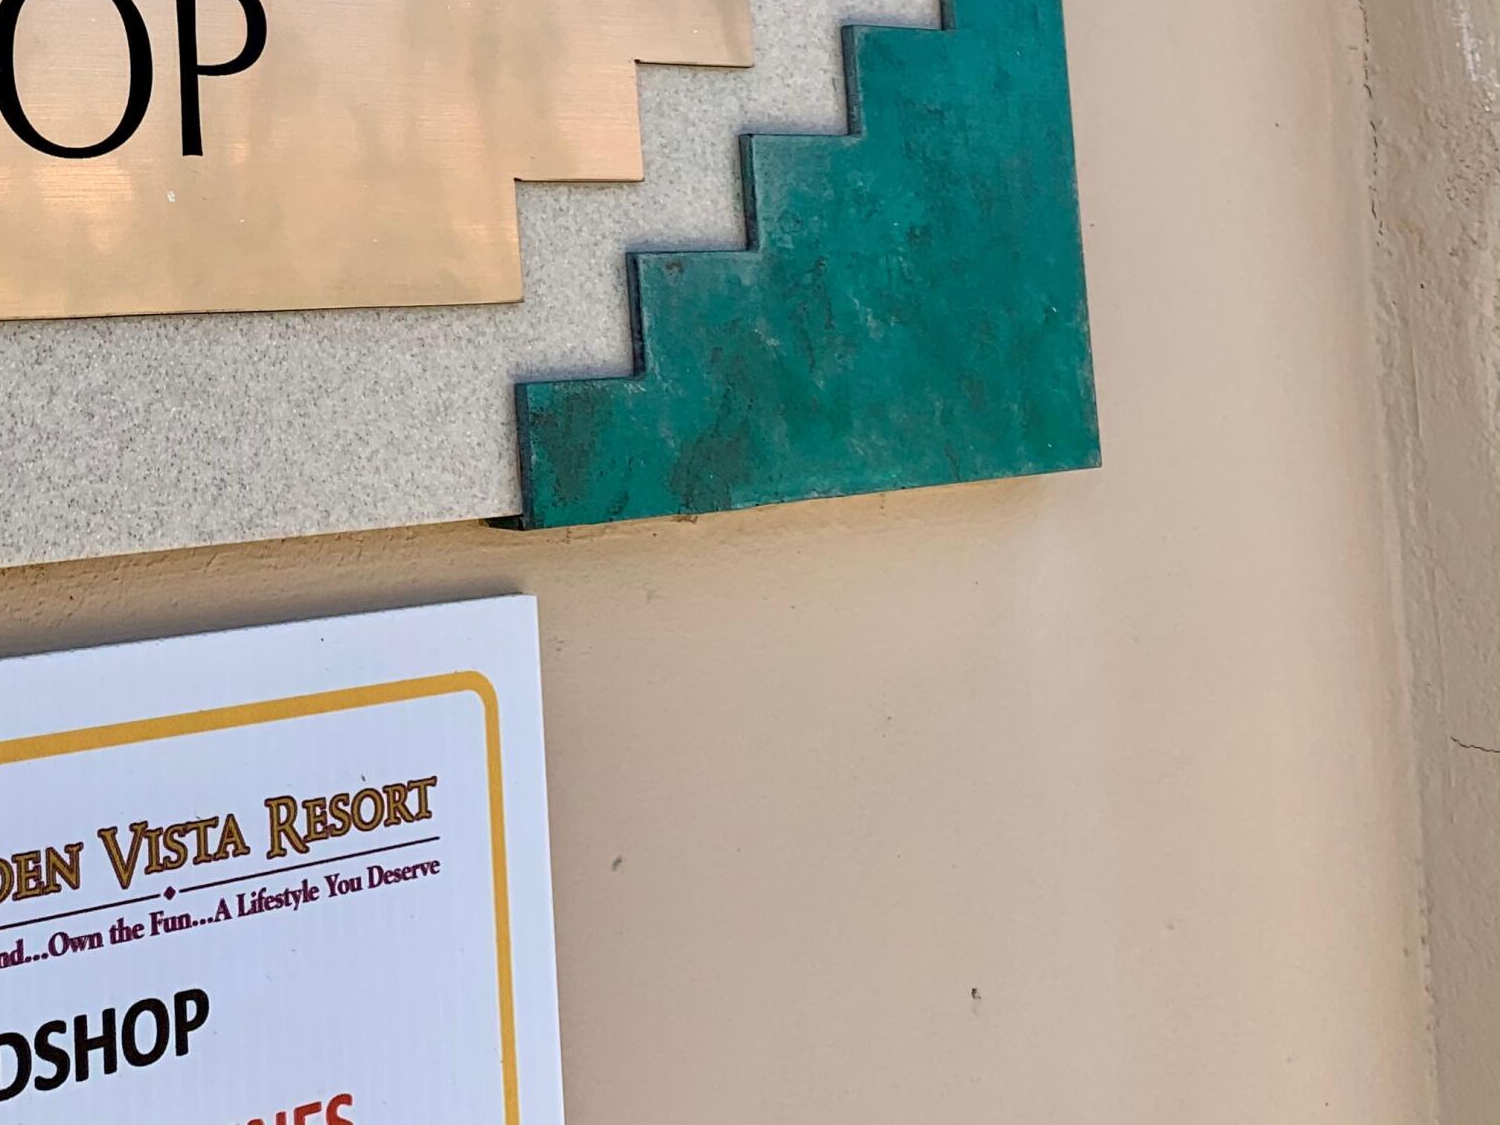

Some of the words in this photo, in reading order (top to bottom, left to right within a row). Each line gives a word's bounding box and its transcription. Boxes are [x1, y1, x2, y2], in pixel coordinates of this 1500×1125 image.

[97, 813, 251, 889] VISTA
[264, 776, 438, 859] RESORT
[109, 917, 145, 945] the
[236, 878, 320, 918] Lifestyle
[324, 873, 363, 898] You
[366, 859, 441, 889] Deserve
